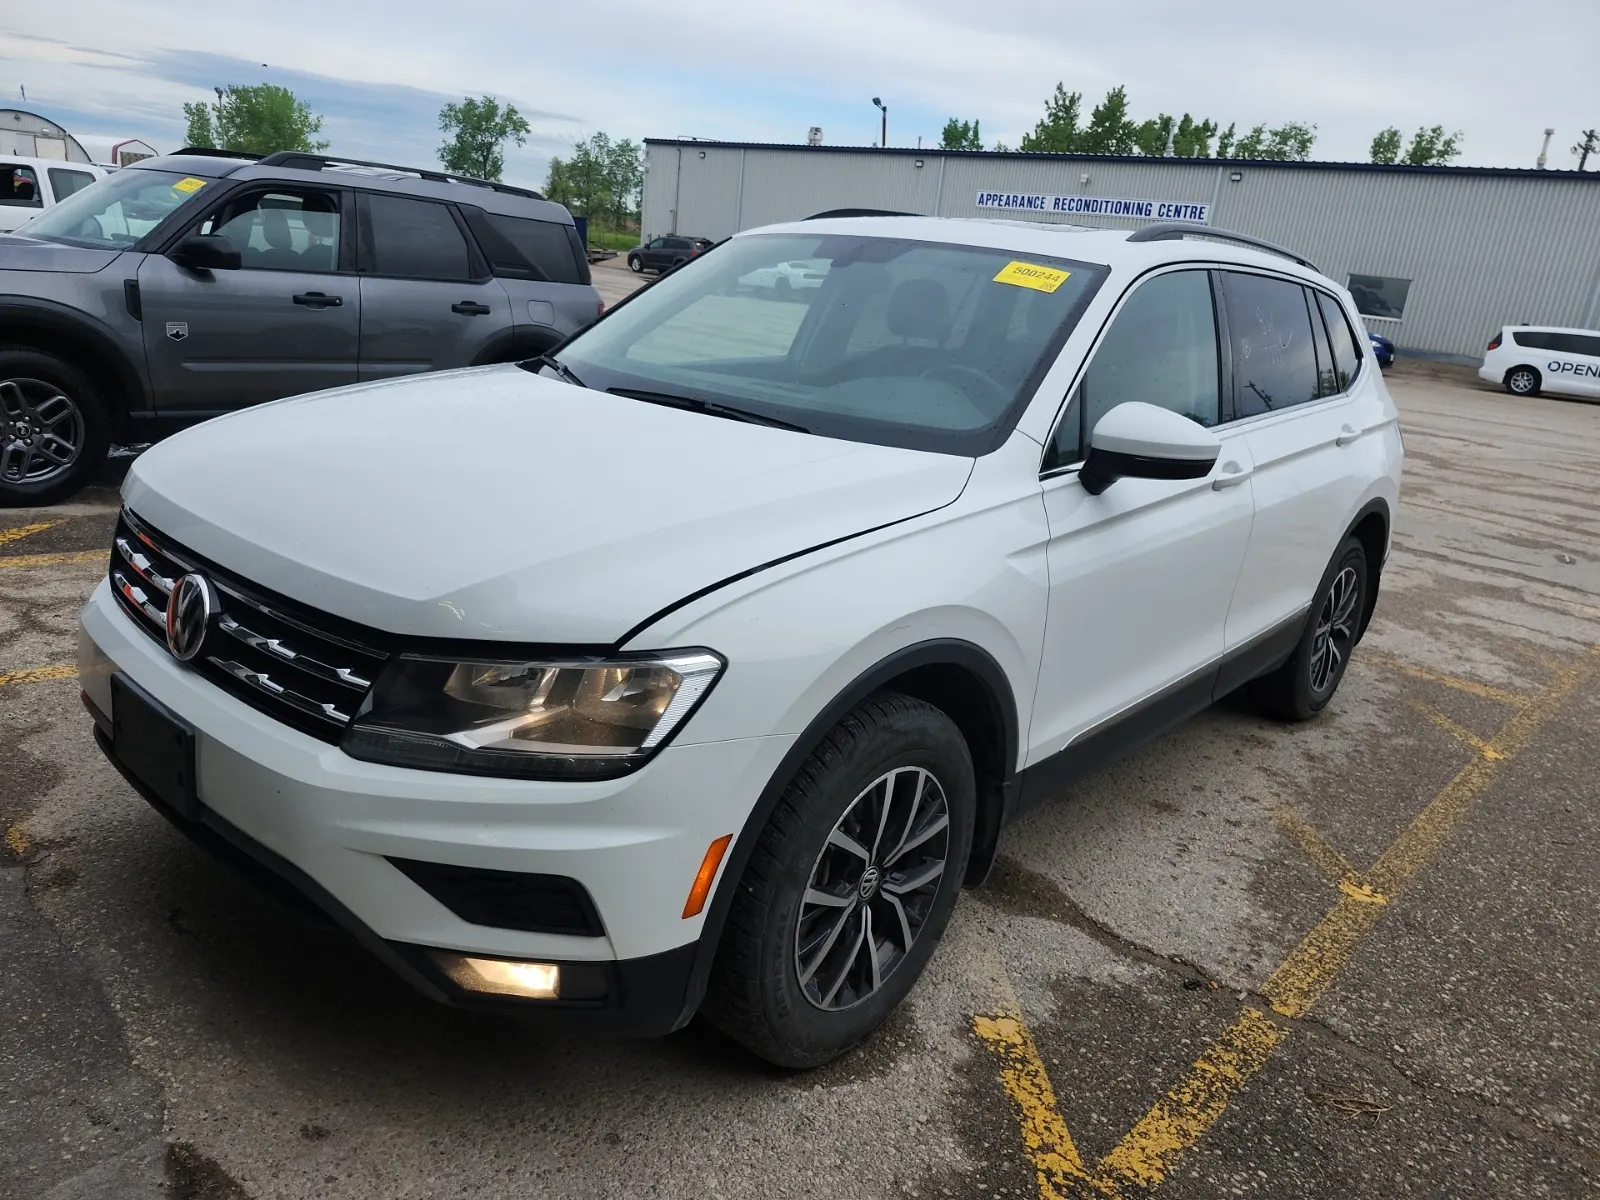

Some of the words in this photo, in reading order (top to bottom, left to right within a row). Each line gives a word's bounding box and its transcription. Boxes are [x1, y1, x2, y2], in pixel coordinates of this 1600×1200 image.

[977, 193, 1046, 210] APPEARANCE
[1053, 197, 1152, 217] RECONDITIONING
[1157, 203, 1206, 221] CENTRE
[1013, 266, 1061, 283] 500244
